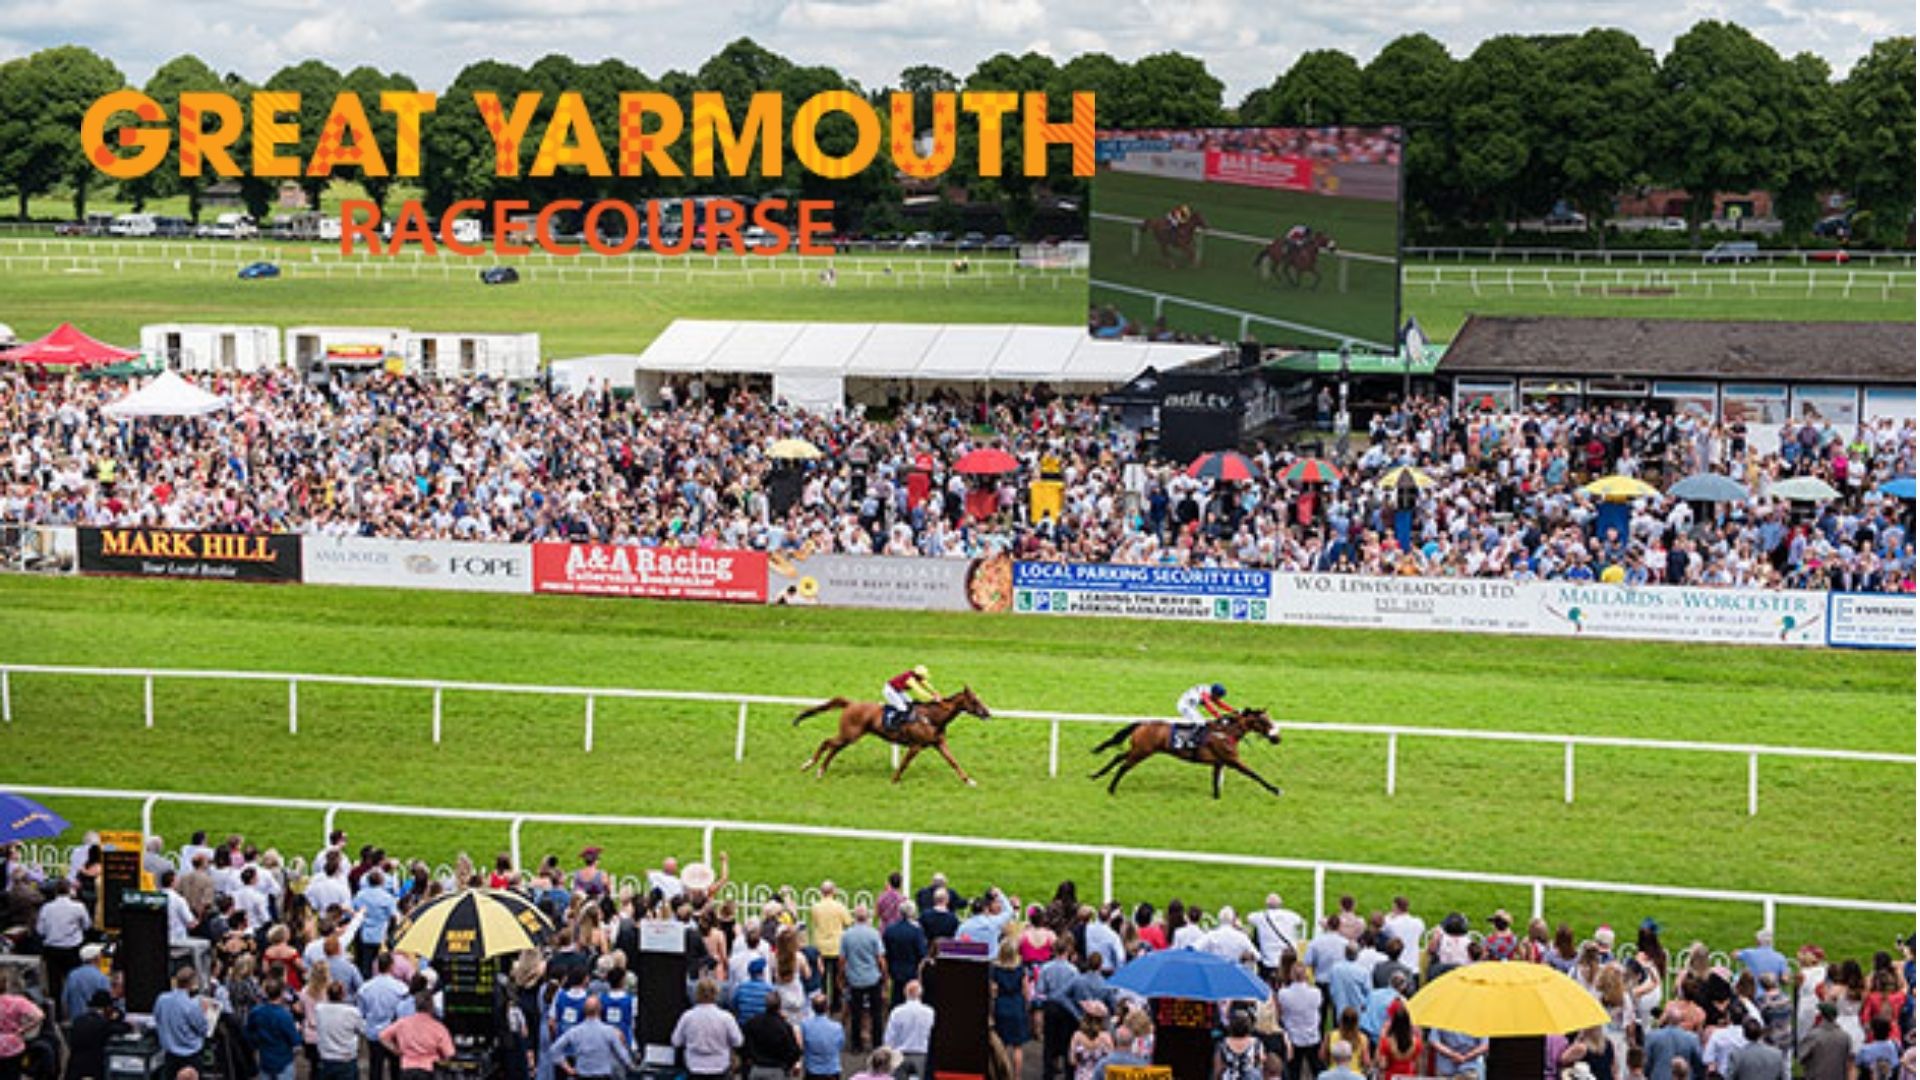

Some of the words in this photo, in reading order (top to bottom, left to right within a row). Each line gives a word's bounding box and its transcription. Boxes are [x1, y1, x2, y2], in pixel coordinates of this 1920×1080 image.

[101, 529, 196, 558] MARK
[202, 534, 277, 561] HILL
[450, 556, 522, 577] FOPE
[566, 546, 630, 576] A&A
[636, 547, 734, 580] Racing
[1020, 563, 1072, 579] LOCAL
[1076, 566, 1148, 581] PARKING
[1152, 568, 1231, 584] SECURITY
[1233, 571, 1264, 586] LTD
[1340, 578, 1391, 592] LEWIS
[1393, 581, 1476, 596] (BADGES)
[1070, 603, 1123, 613] PARKING
[1134, 595, 1157, 603] THE
[1558, 587, 1664, 606] MALLARDS
[1682, 592, 1808, 611] WORCESTER
